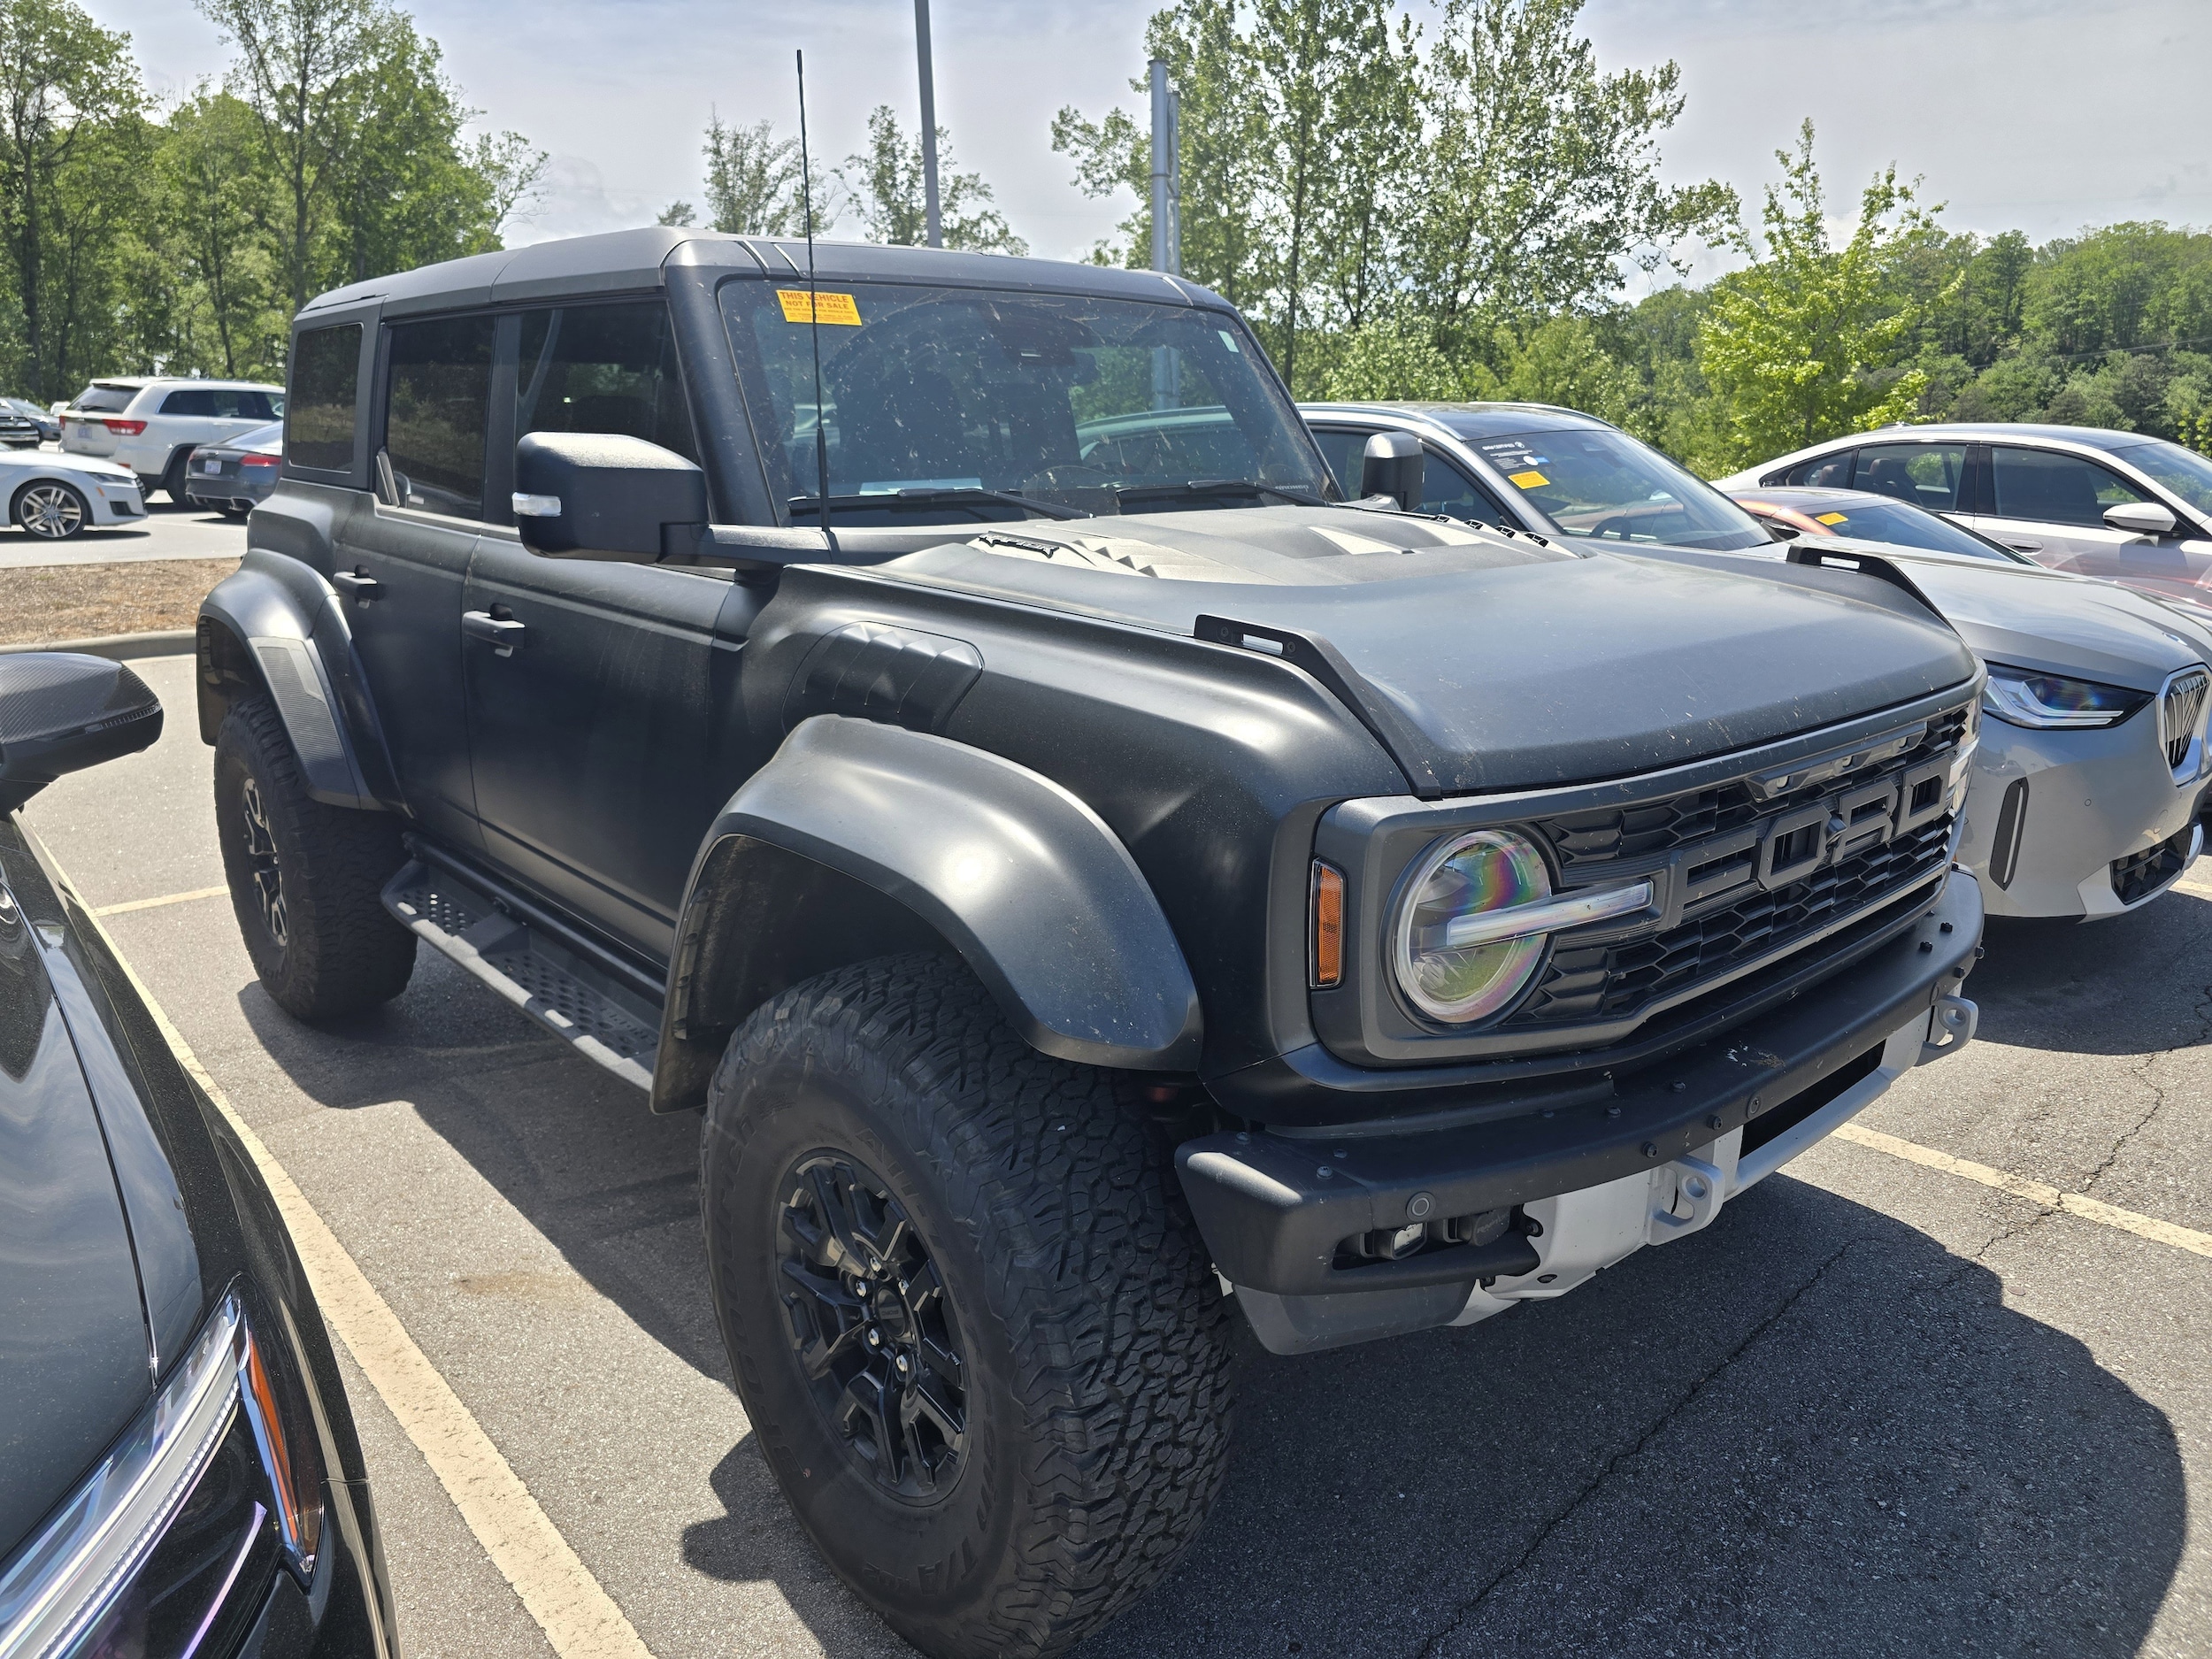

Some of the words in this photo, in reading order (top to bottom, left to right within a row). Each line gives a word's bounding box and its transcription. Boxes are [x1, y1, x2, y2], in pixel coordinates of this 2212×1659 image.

[780, 291, 803, 300] THIS
[805, 293, 849, 303] VEHICLE
[1656, 754, 1952, 931] FORD
